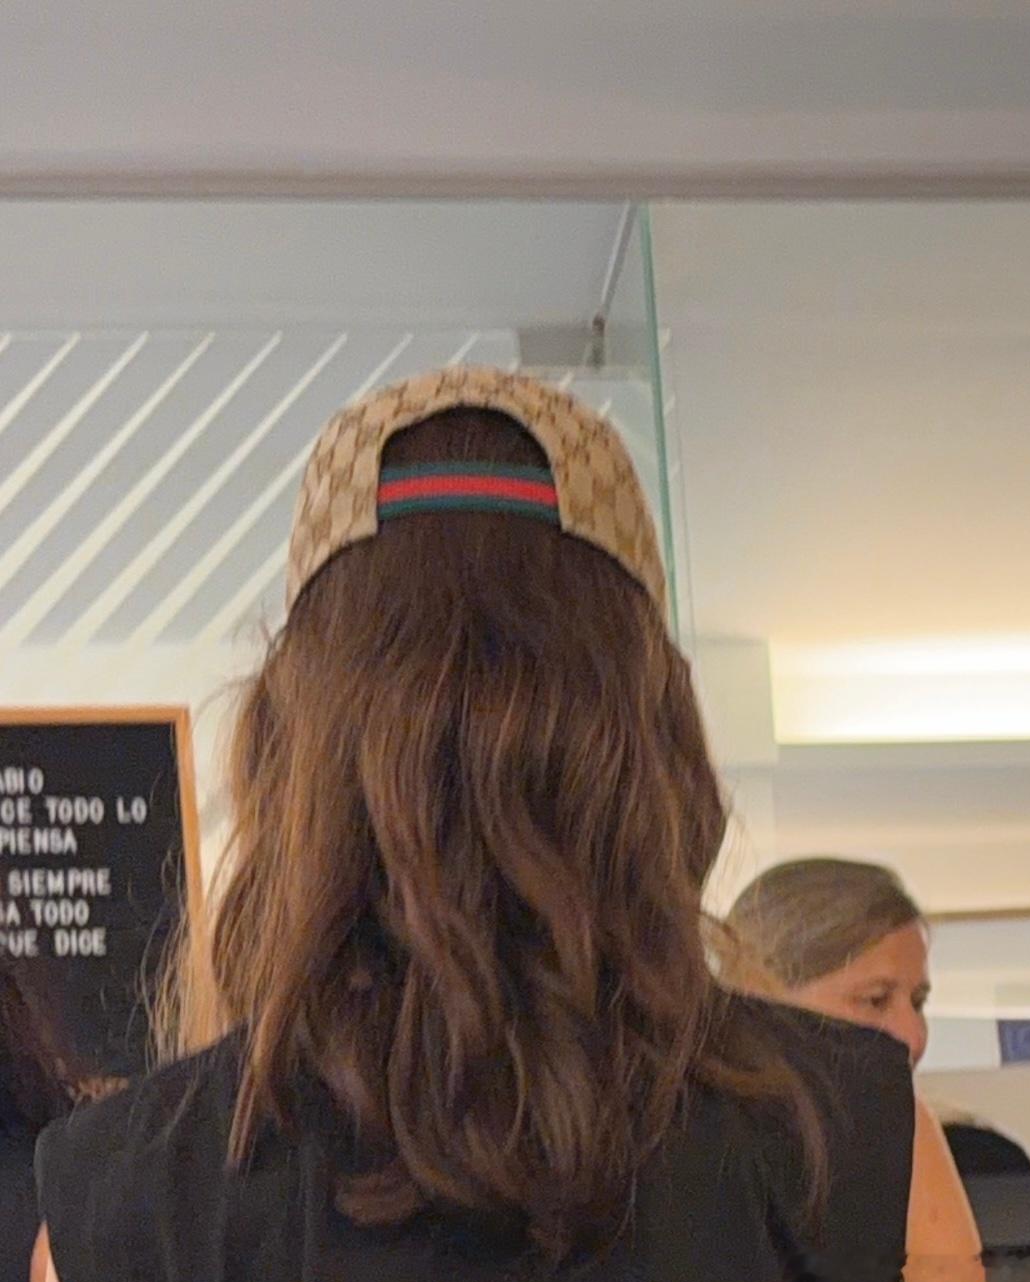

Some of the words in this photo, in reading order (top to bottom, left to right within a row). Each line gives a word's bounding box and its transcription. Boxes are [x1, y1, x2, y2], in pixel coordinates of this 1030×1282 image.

[46, 796, 104, 825] TODO
[116, 796, 148, 825] LO
[8, 867, 111, 897] SIEMPRE
[30, 899, 90, 927] TODO
